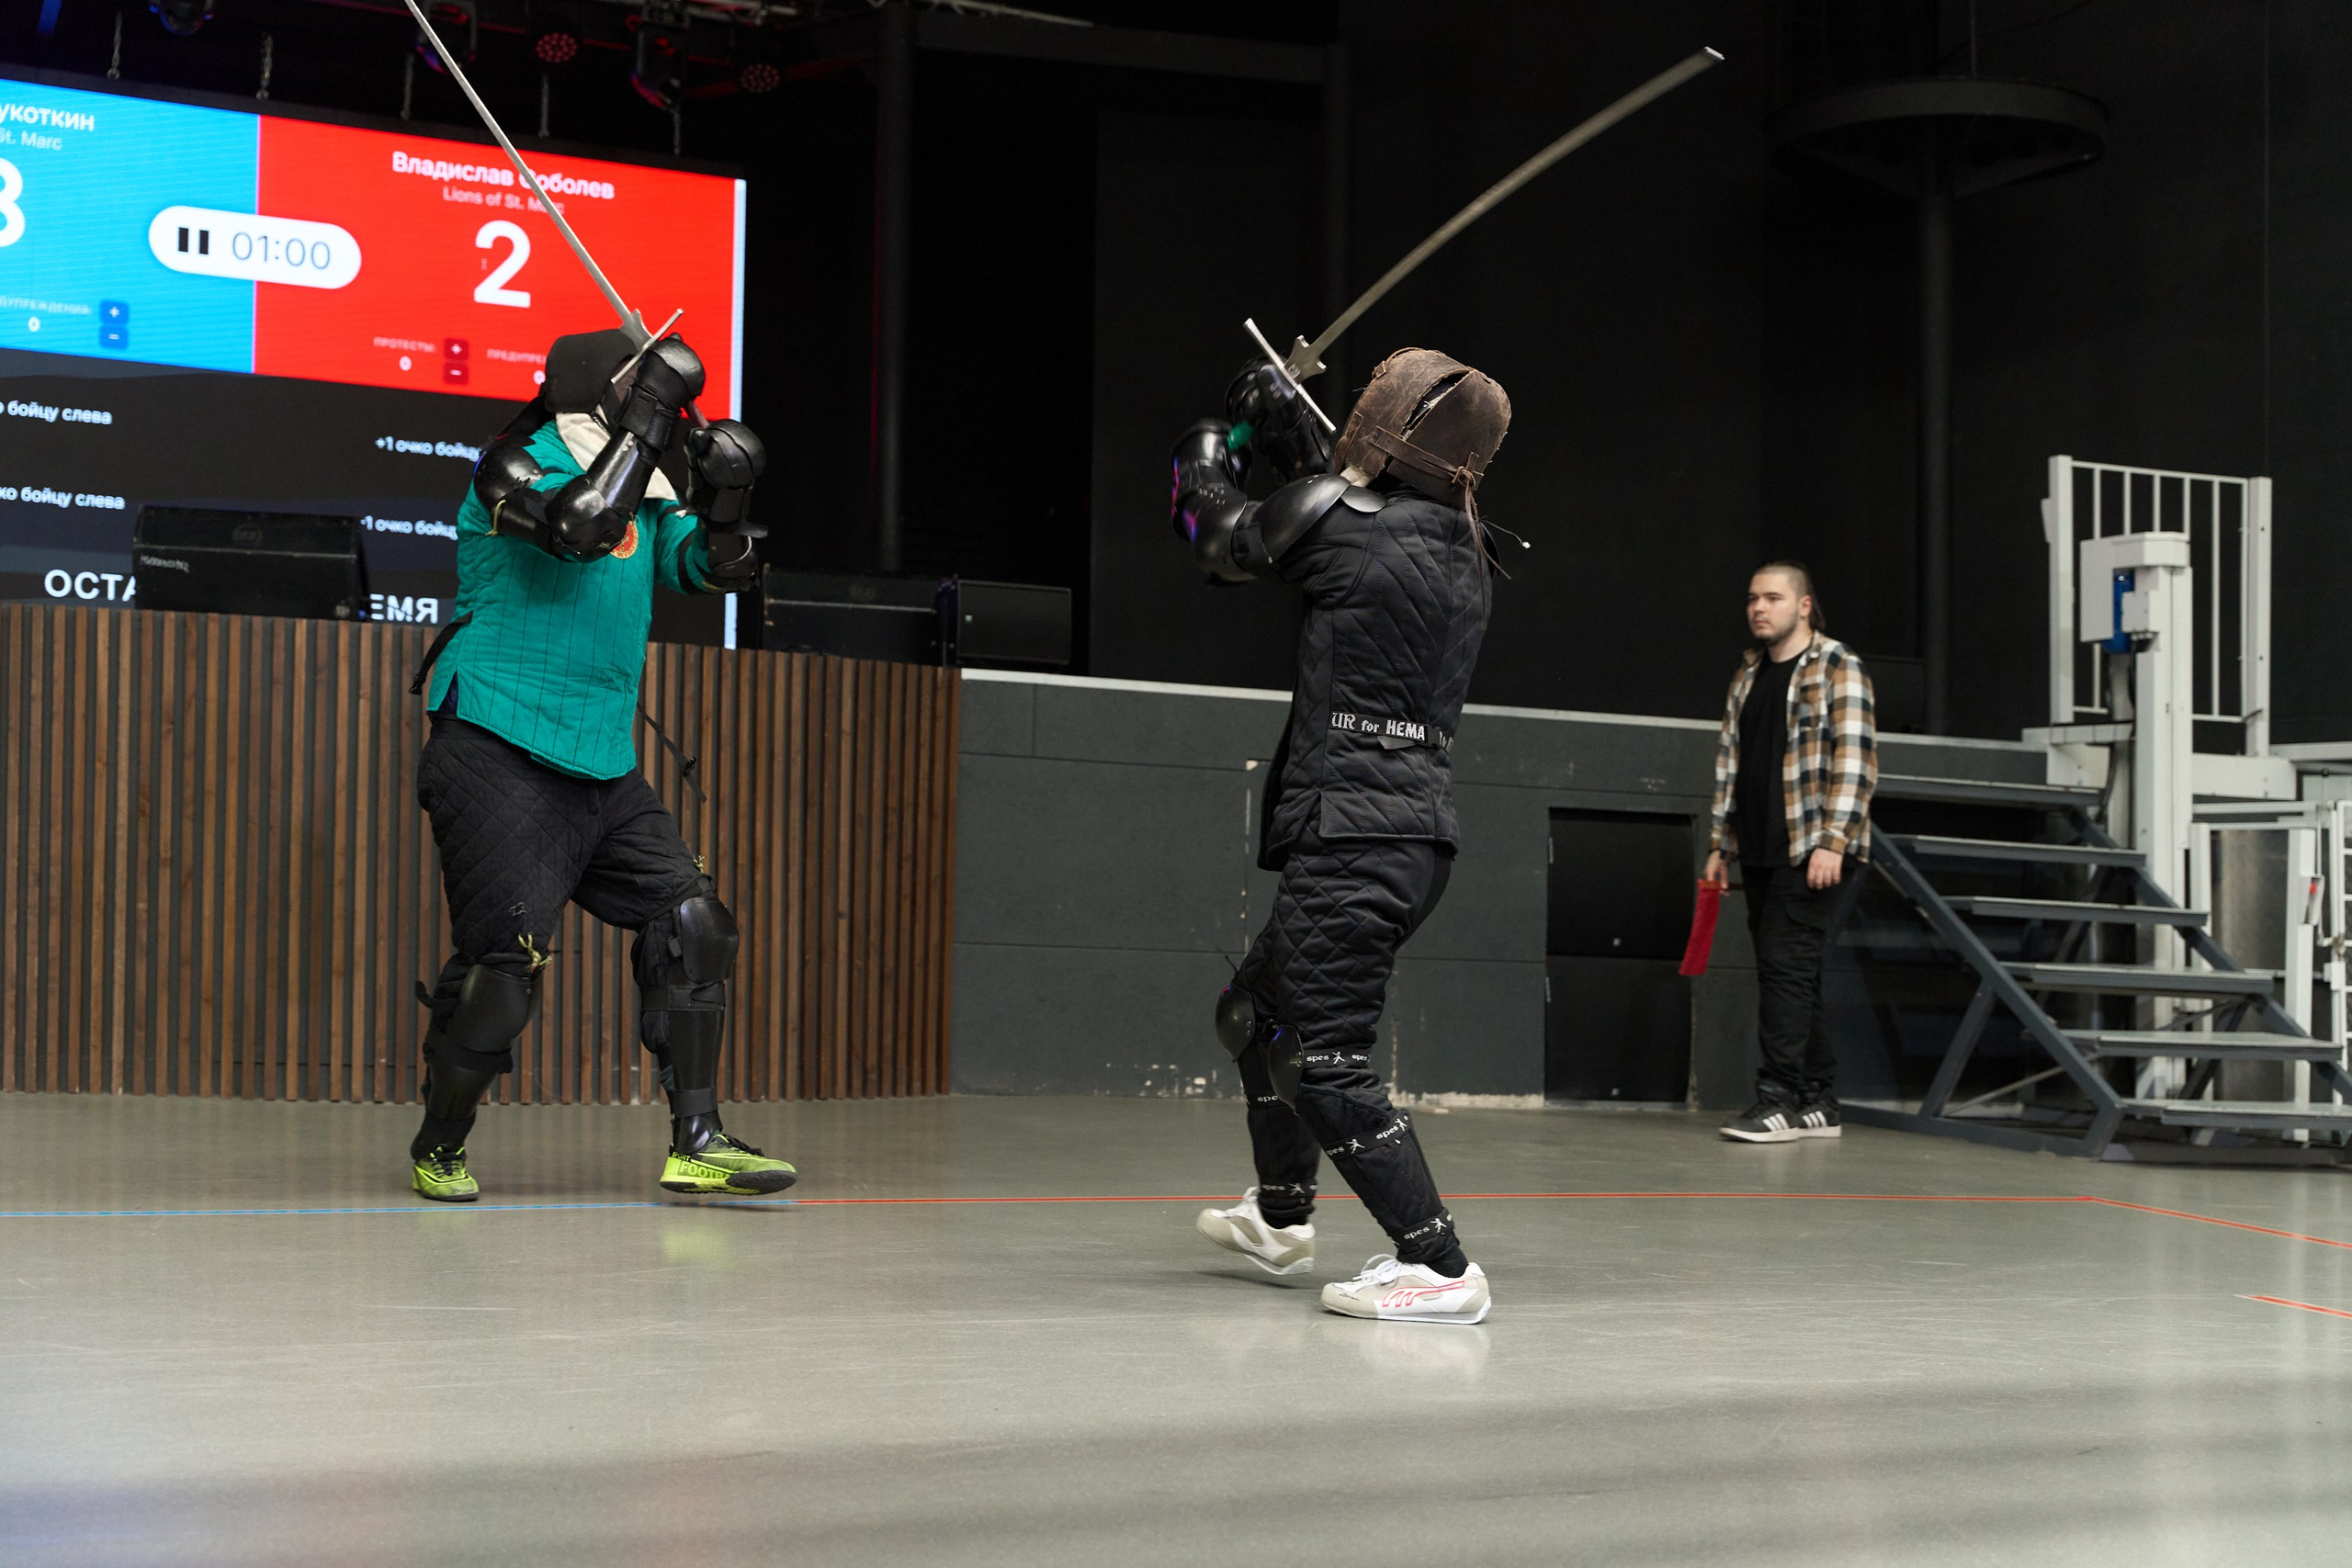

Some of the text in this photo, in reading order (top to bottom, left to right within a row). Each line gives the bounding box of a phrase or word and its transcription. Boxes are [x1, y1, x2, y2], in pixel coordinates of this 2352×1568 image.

[20, 130, 63, 152] Marc
[392, 151, 514, 187] Владислав
[443, 186, 483, 205] Lions
[485, 191, 503, 207] of
[232, 231, 331, 269] 01:00
[473, 220, 531, 309] 2
[28, 316, 40, 333] 0
[399, 355, 412, 371] 0
[7, 400, 60, 423] бойцу
[62, 407, 113, 425] слева
[395, 439, 434, 456] очко
[20, 487, 73, 508] бойцу
[74, 493, 126, 510] слева
[375, 518, 413, 535] очко
[1361, 719, 1380, 733] for
[1385, 719, 1425, 741] HEMA
